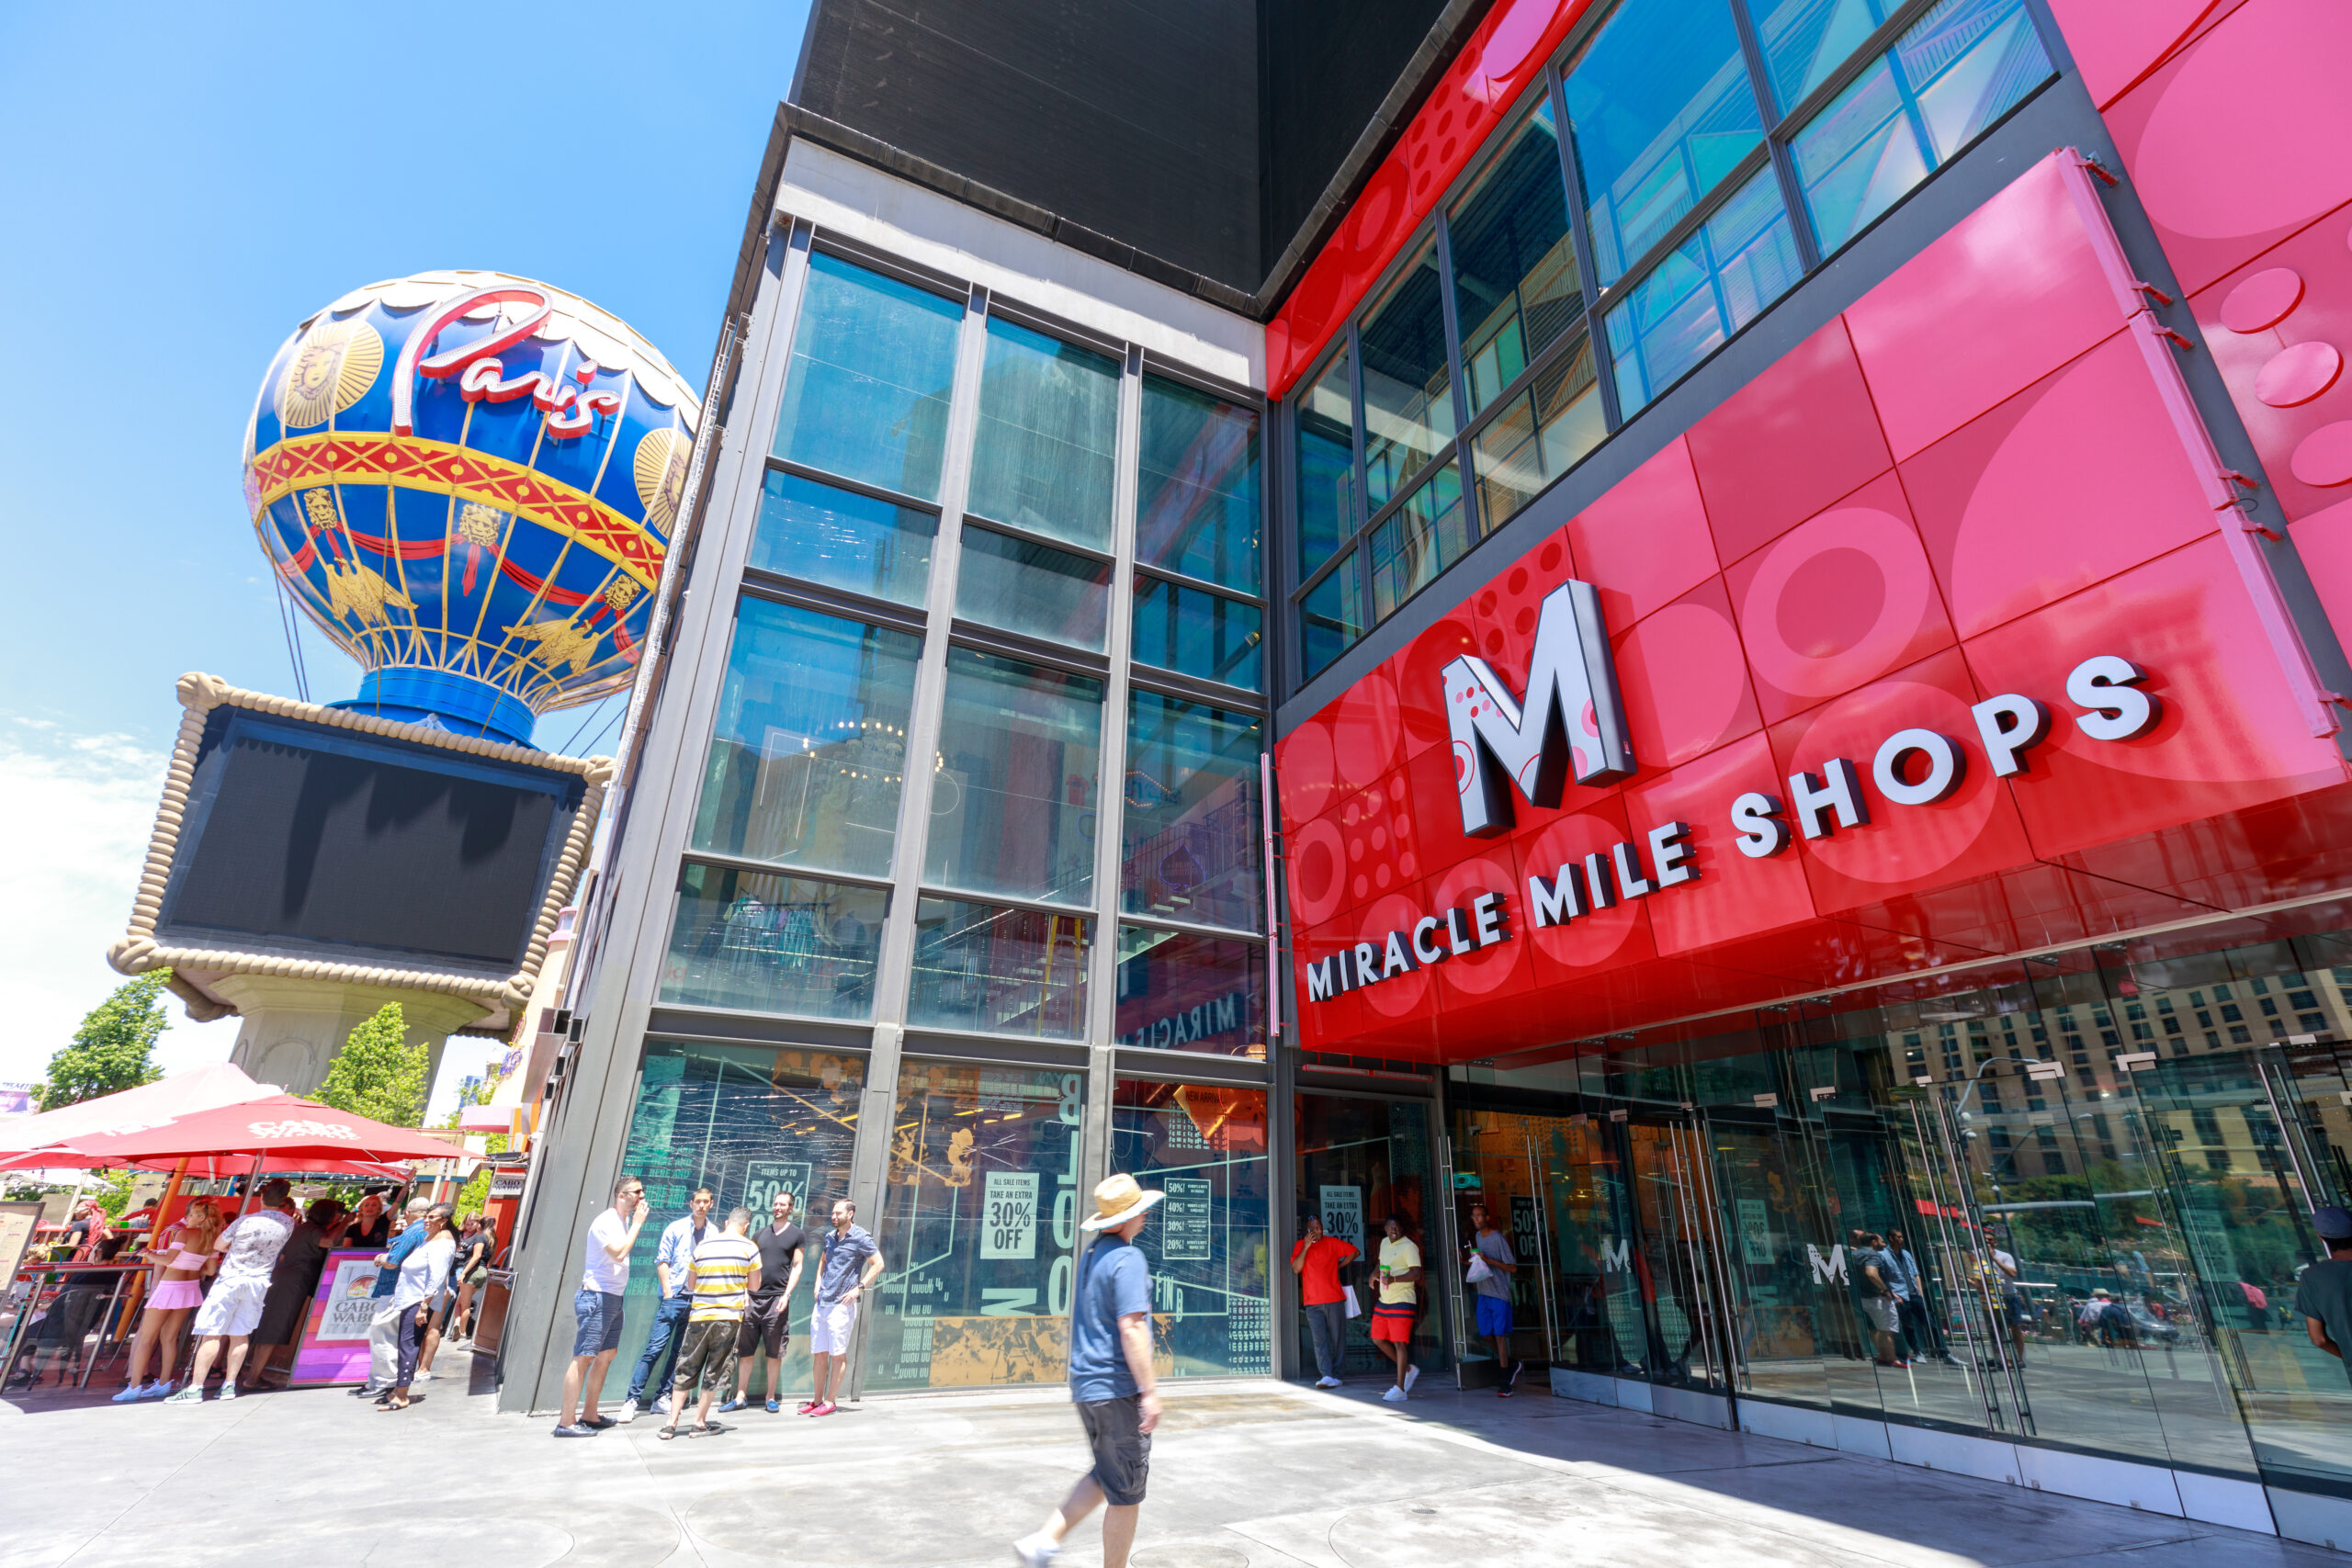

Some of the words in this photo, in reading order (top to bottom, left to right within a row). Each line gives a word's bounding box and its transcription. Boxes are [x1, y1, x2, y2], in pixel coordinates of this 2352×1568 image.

[392, 284, 621, 439] Paris
[1441, 578, 1637, 840] M
[1306, 892, 1513, 1002] MIRACLE
[1529, 821, 1702, 928] MILE
[1731, 655, 2164, 858] SHOPS
[649, 1168, 670, 1178] HERE
[672, 1168, 690, 1179] AND
[761, 1168, 779, 1177] ITEMS
[779, 1168, 789, 1177] UP
[789, 1168, 797, 1177] TO
[993, 1178, 1002, 1186] ALL
[989, 1190, 1004, 1199] TAKE
[1005, 1190, 1013, 1199] AN
[1014, 1190, 1033, 1200] EXTRA
[1324, 1201, 1336, 1210] TAKE
[1343, 1201, 1358, 1210] EXTRA
[989, 1201, 1031, 1228] 30%
[1327, 1212, 1359, 1235] 30%
[634, 1237, 658, 1247] HERE
[994, 1228, 1023, 1250] OFF
[631, 1256, 654, 1266] HERE
[1806, 1243, 1850, 1286] M
